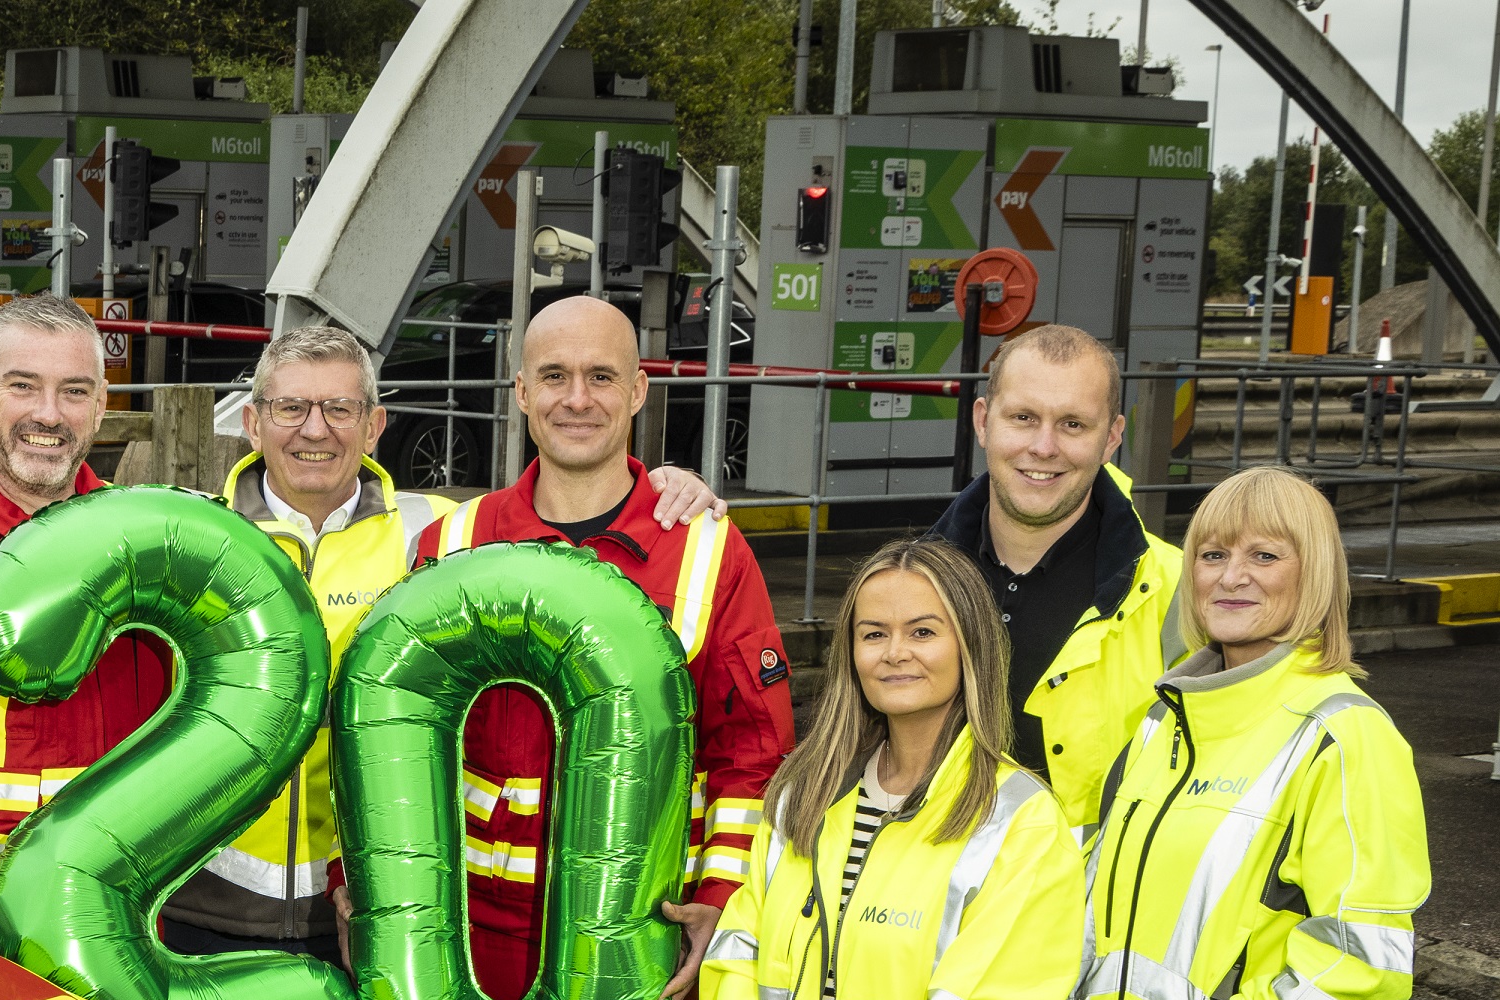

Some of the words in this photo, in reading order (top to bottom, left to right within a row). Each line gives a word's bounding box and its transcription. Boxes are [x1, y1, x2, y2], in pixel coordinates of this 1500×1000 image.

[211, 137, 261, 155] M6toll
[1148, 145, 1203, 168] M6toll
[477, 177, 504, 194] pay
[1000, 191, 1028, 209] pay
[237, 214, 264, 222] reversing
[5, 231, 31, 241] TOLL
[777, 273, 817, 301] 501
[911, 274, 941, 287] TOLL
[1187, 776, 1249, 795] Mtoll
[859, 906, 923, 930] M6toll
